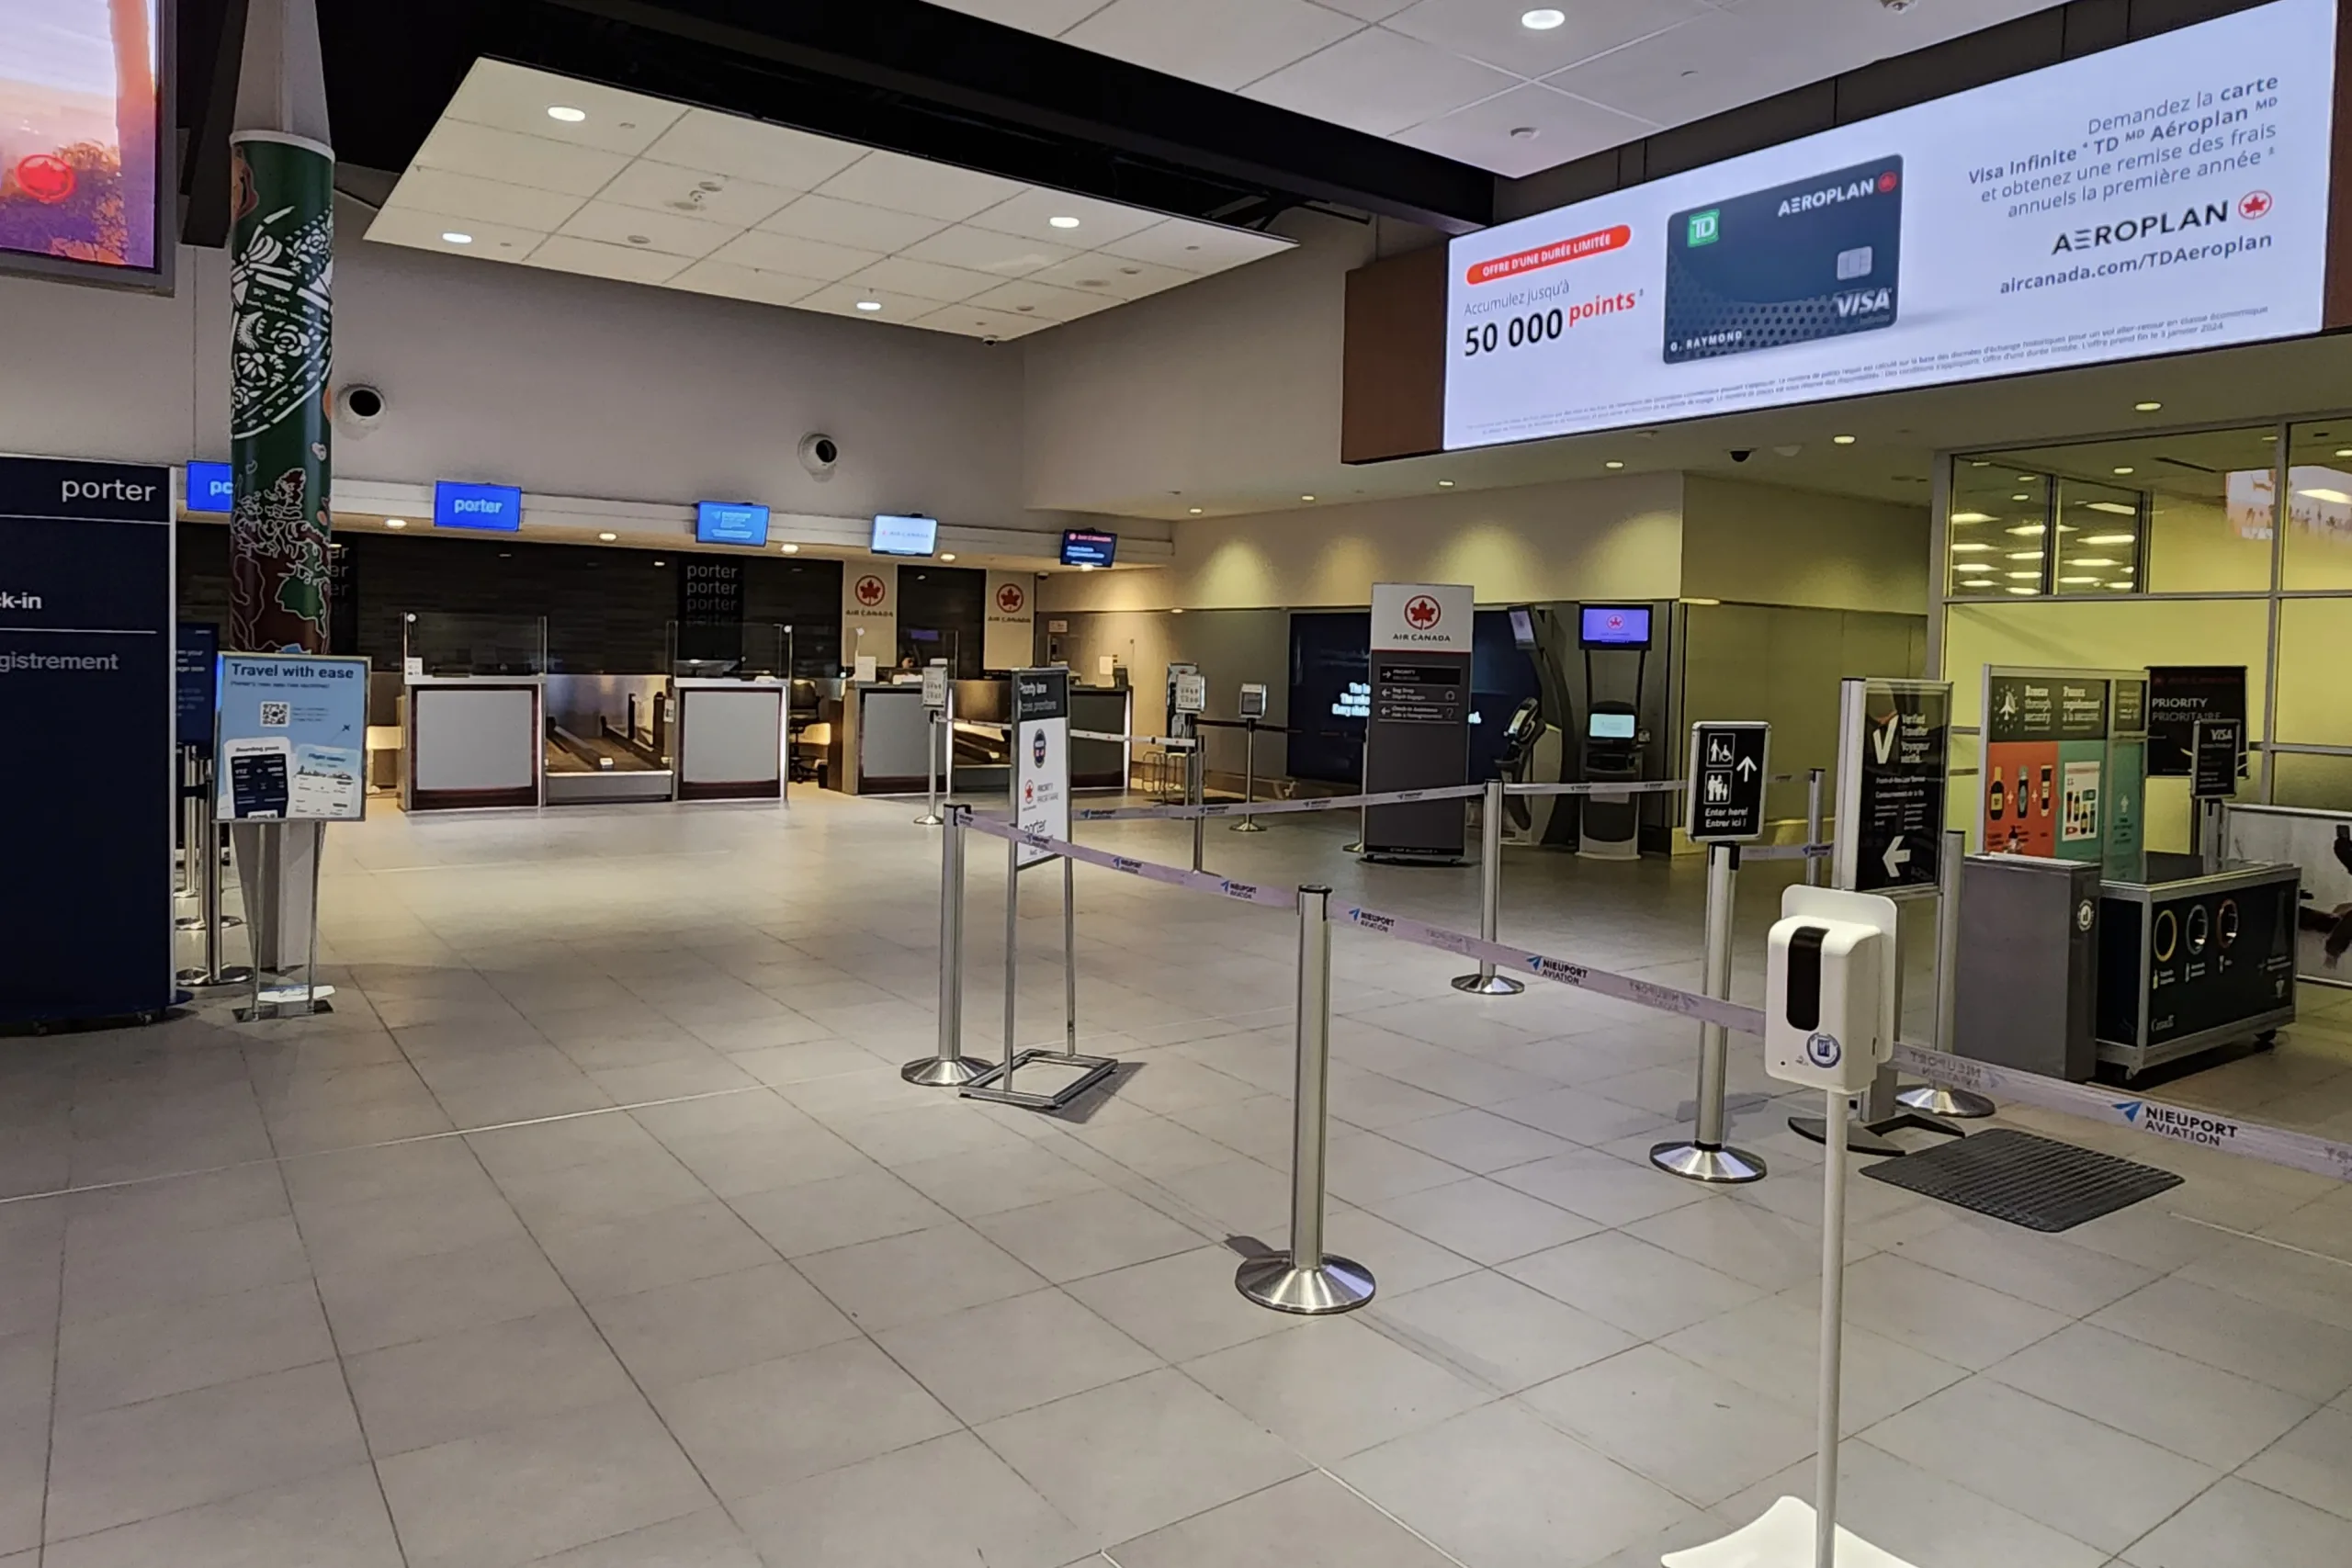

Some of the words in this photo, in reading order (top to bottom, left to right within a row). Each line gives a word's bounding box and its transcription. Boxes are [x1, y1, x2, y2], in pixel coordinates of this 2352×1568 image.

[2088, 96, 2190, 135] Demandez
[2197, 89, 2212, 109] la
[2220, 76, 2278, 102] carte
[1969, 166, 2004, 186] Visa
[2010, 147, 2076, 175] Infinite
[2094, 136, 2120, 155] TD
[2125, 128, 2145, 142] MD
[2150, 106, 2248, 141] Aéroplan
[2255, 96, 2278, 111] MD
[1981, 186, 1997, 202] et
[2001, 171, 2071, 199] obtenez
[2076, 163, 2111, 182] une
[2117, 144, 2182, 173] remise
[2188, 135, 2223, 156] des
[2231, 121, 2276, 147] frais
[2007, 191, 2076, 219] annuels
[2082, 185, 2097, 202] la
[2103, 164, 2191, 200] première
[2197, 147, 2261, 176] année
[1778, 178, 1874, 217] AEROPLAN
[1692, 217, 1715, 239] TD
[2051, 199, 2229, 255] AEROPLAN
[1482, 261, 1510, 277] OFFRE
[1512, 255, 1539, 269] D'UNE
[1542, 244, 1570, 263] DURÉE
[1574, 233, 1611, 254] LIMITÉE
[2000, 234, 2272, 294] aircanada.com/TDAeroplan
[1464, 292, 1525, 316] Accumulez
[1527, 279, 1569, 306] jusqu'à
[1838, 288, 1891, 318] VISA
[1464, 322, 1498, 356] 50
[1509, 308, 1563, 347] 000
[1569, 292, 1635, 326] points
[2200, 321, 2223, 333] 2024
[1686, 331, 1743, 349] RAYMOND
[62, 479, 157, 502] porter
[454, 499, 503, 513] porter
[687, 564, 739, 580] porter
[687, 581, 738, 596] porter
[687, 597, 737, 612] porter
[861, 610, 894, 618] CANADA
[1393, 633, 1409, 641] AIR
[1410, 634, 1451, 642] CANADA
[232, 662, 278, 677] Travel
[283, 665, 314, 678] with
[318, 668, 355, 679] ease
[2152, 697, 2209, 708] PRIORITY
[2152, 711, 2222, 722] PRIORITAIRE
[2211, 729, 2233, 740] VISA
[1705, 807, 1727, 817] Enter
[1705, 818, 1730, 828] Entrer
[1361, 911, 1396, 927] NIEUPORT
[1543, 959, 1589, 978] NIEUPORT
[1542, 970, 1579, 986] AVIATION
[2145, 1105, 2239, 1138] NIEUPORT
[2145, 1120, 2221, 1146] AVIATION
